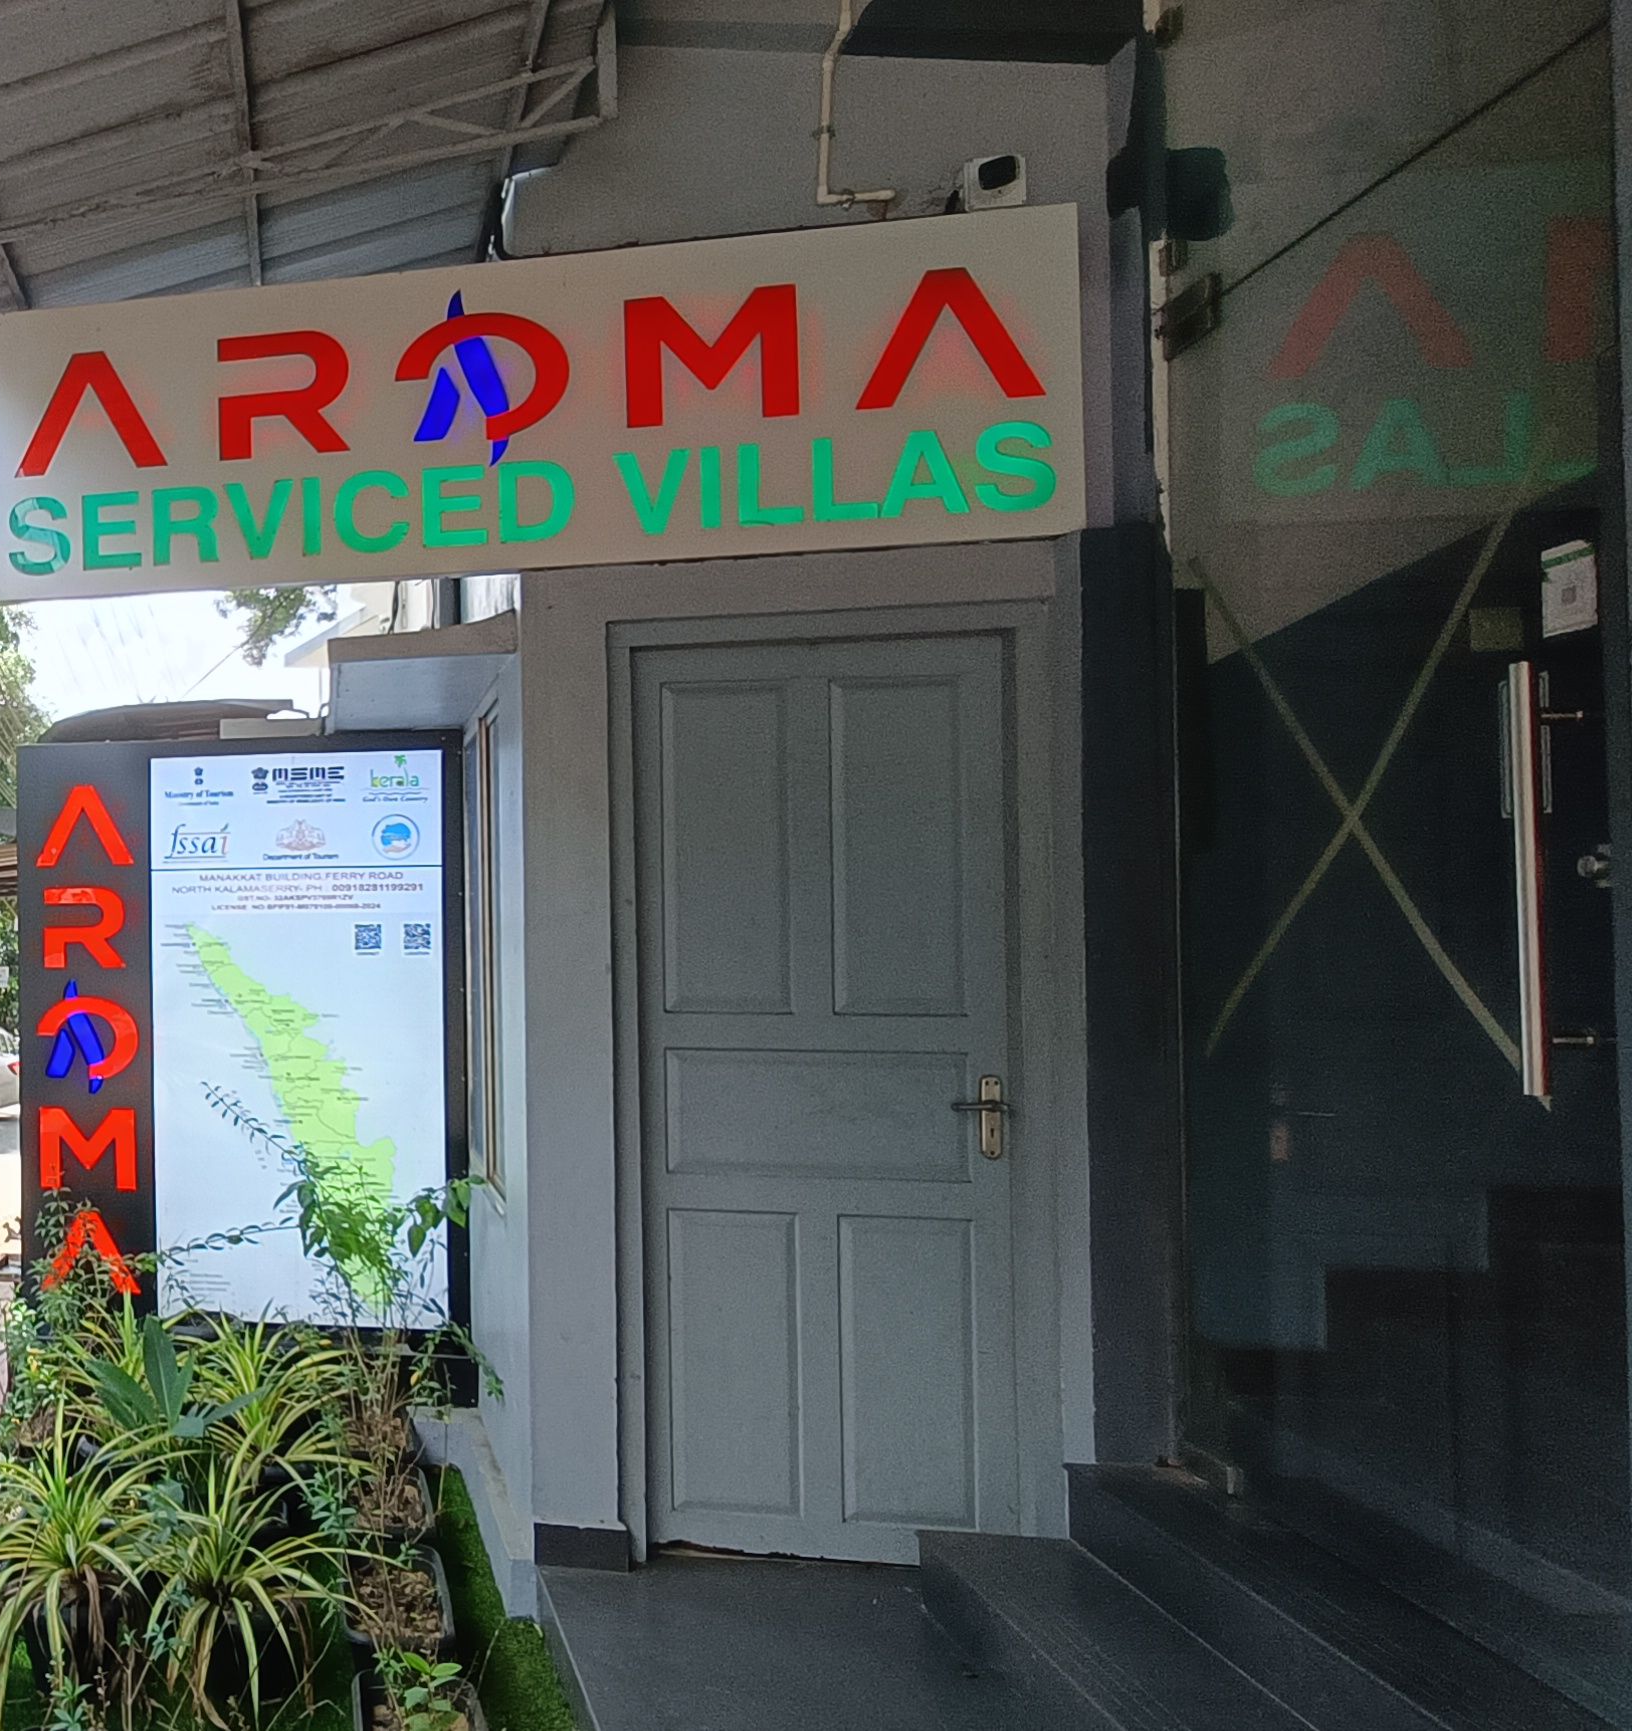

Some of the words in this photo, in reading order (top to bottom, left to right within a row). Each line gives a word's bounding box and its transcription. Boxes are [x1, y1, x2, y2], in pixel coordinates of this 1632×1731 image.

[15, 267, 1046, 477] AROMA
[7, 460, 575, 576] SERVICED
[613, 422, 1057, 537] VILLAS
[370, 760, 420, 788] kerala
[164, 823, 230, 860] fssai
[171, 886, 212, 894] NORTH
[368, 871, 404, 880] ROAD
[36, 784, 141, 1295] AROMA
